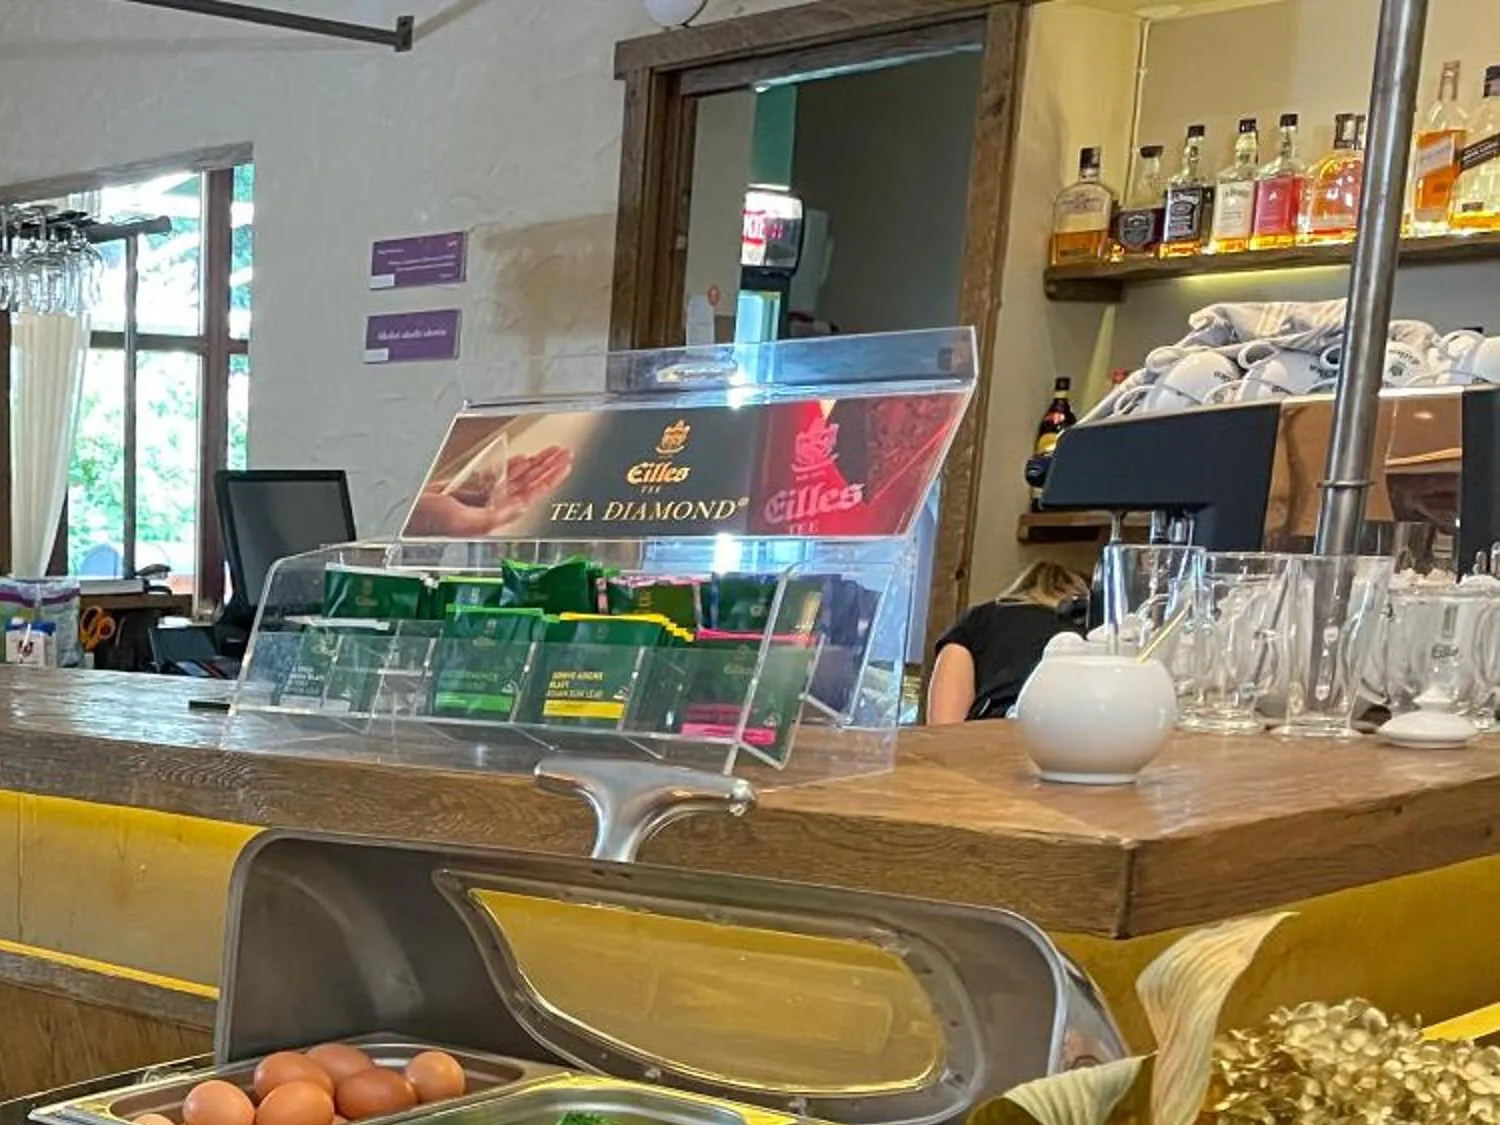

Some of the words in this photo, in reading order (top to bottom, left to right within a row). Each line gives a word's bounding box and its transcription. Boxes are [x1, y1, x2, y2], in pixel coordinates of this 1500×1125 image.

[627, 461, 691, 484] Eilles
[550, 503, 593, 521] TEA
[764, 482, 865, 525] Eilles
